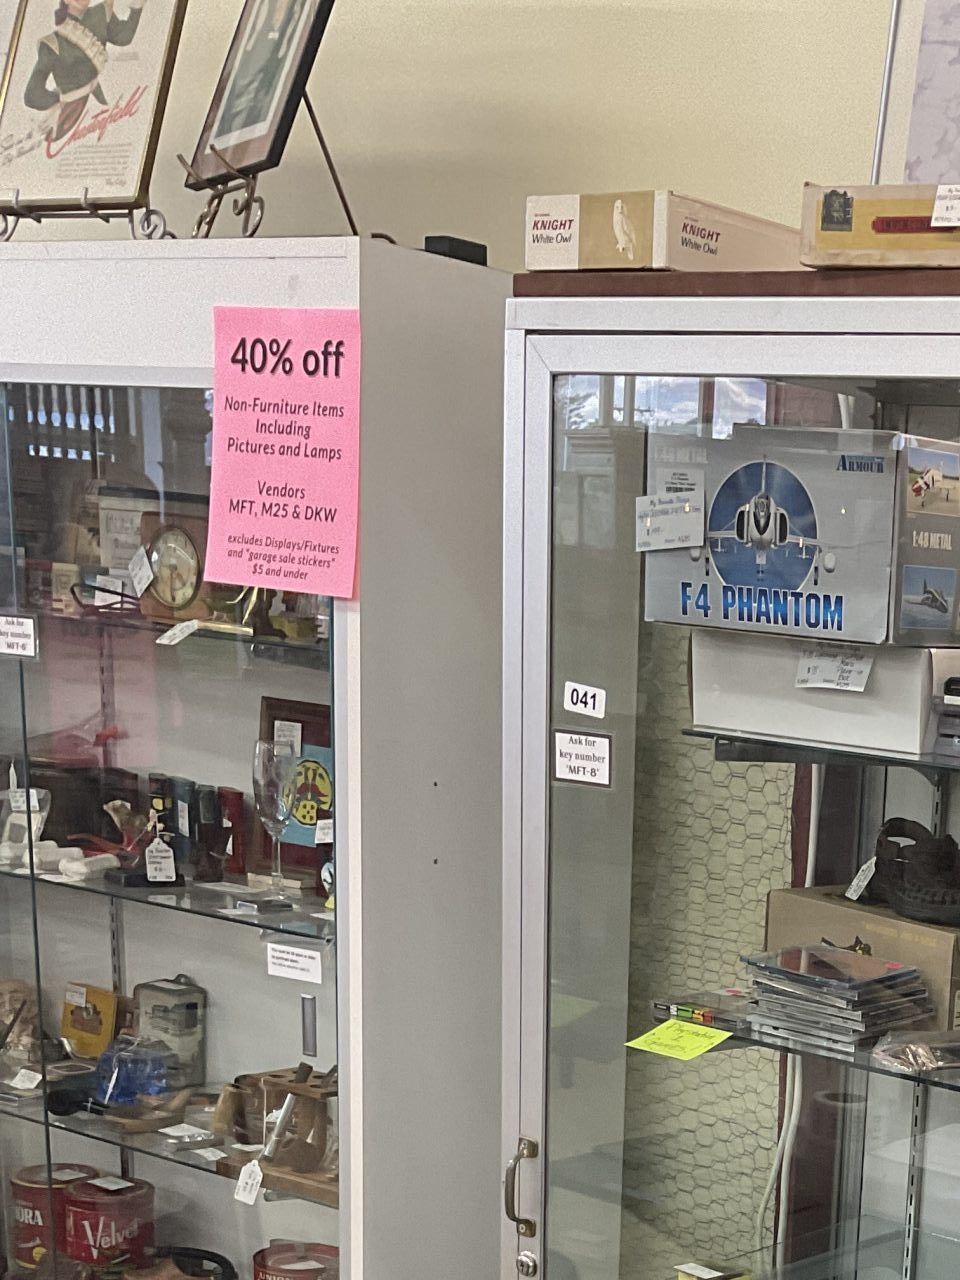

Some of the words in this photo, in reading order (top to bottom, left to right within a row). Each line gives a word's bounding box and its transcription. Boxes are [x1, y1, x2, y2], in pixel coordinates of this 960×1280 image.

[532, 218, 575, 231] KNIGHT
[681, 222, 722, 244] KNIGHT
[532, 233, 554, 244] White
[555, 233, 572, 243] Owl
[680, 236, 702, 251] White
[702, 242, 719, 256] Owl
[230, 336, 293, 376] 40%
[302, 339, 345, 378] off
[224, 395, 309, 416] Non-Furniture
[312, 400, 345, 418] Items
[255, 418, 311, 440] Including
[227, 437, 276, 456] Pictures
[278, 441, 300, 458] and
[303, 442, 343, 463] Lamps
[257, 480, 306, 500] Vendors
[228, 498, 258, 518] MFT,
[261, 501, 289, 518] M25
[291, 504, 300, 519] &
[304, 505, 338, 523] DKW
[227, 533, 264, 547] excludes
[264, 536, 341, 555] Displays/Fixtures
[929, 532, 953, 551] METAL
[227, 548, 244, 559] and
[278, 553, 297, 565] sale
[252, 564, 264, 575] $5
[264, 566, 282, 577] and
[282, 568, 309, 581] under
[681, 582, 712, 618] F4
[721, 585, 844, 632] PHANTOM
[0, 630, 10, 639] ey
[570, 687, 597, 711] 041
[568, 735, 584, 746] Ask
[584, 737, 597, 748] for
[559, 748, 574, 762] key
[574, 752, 606, 764] number
